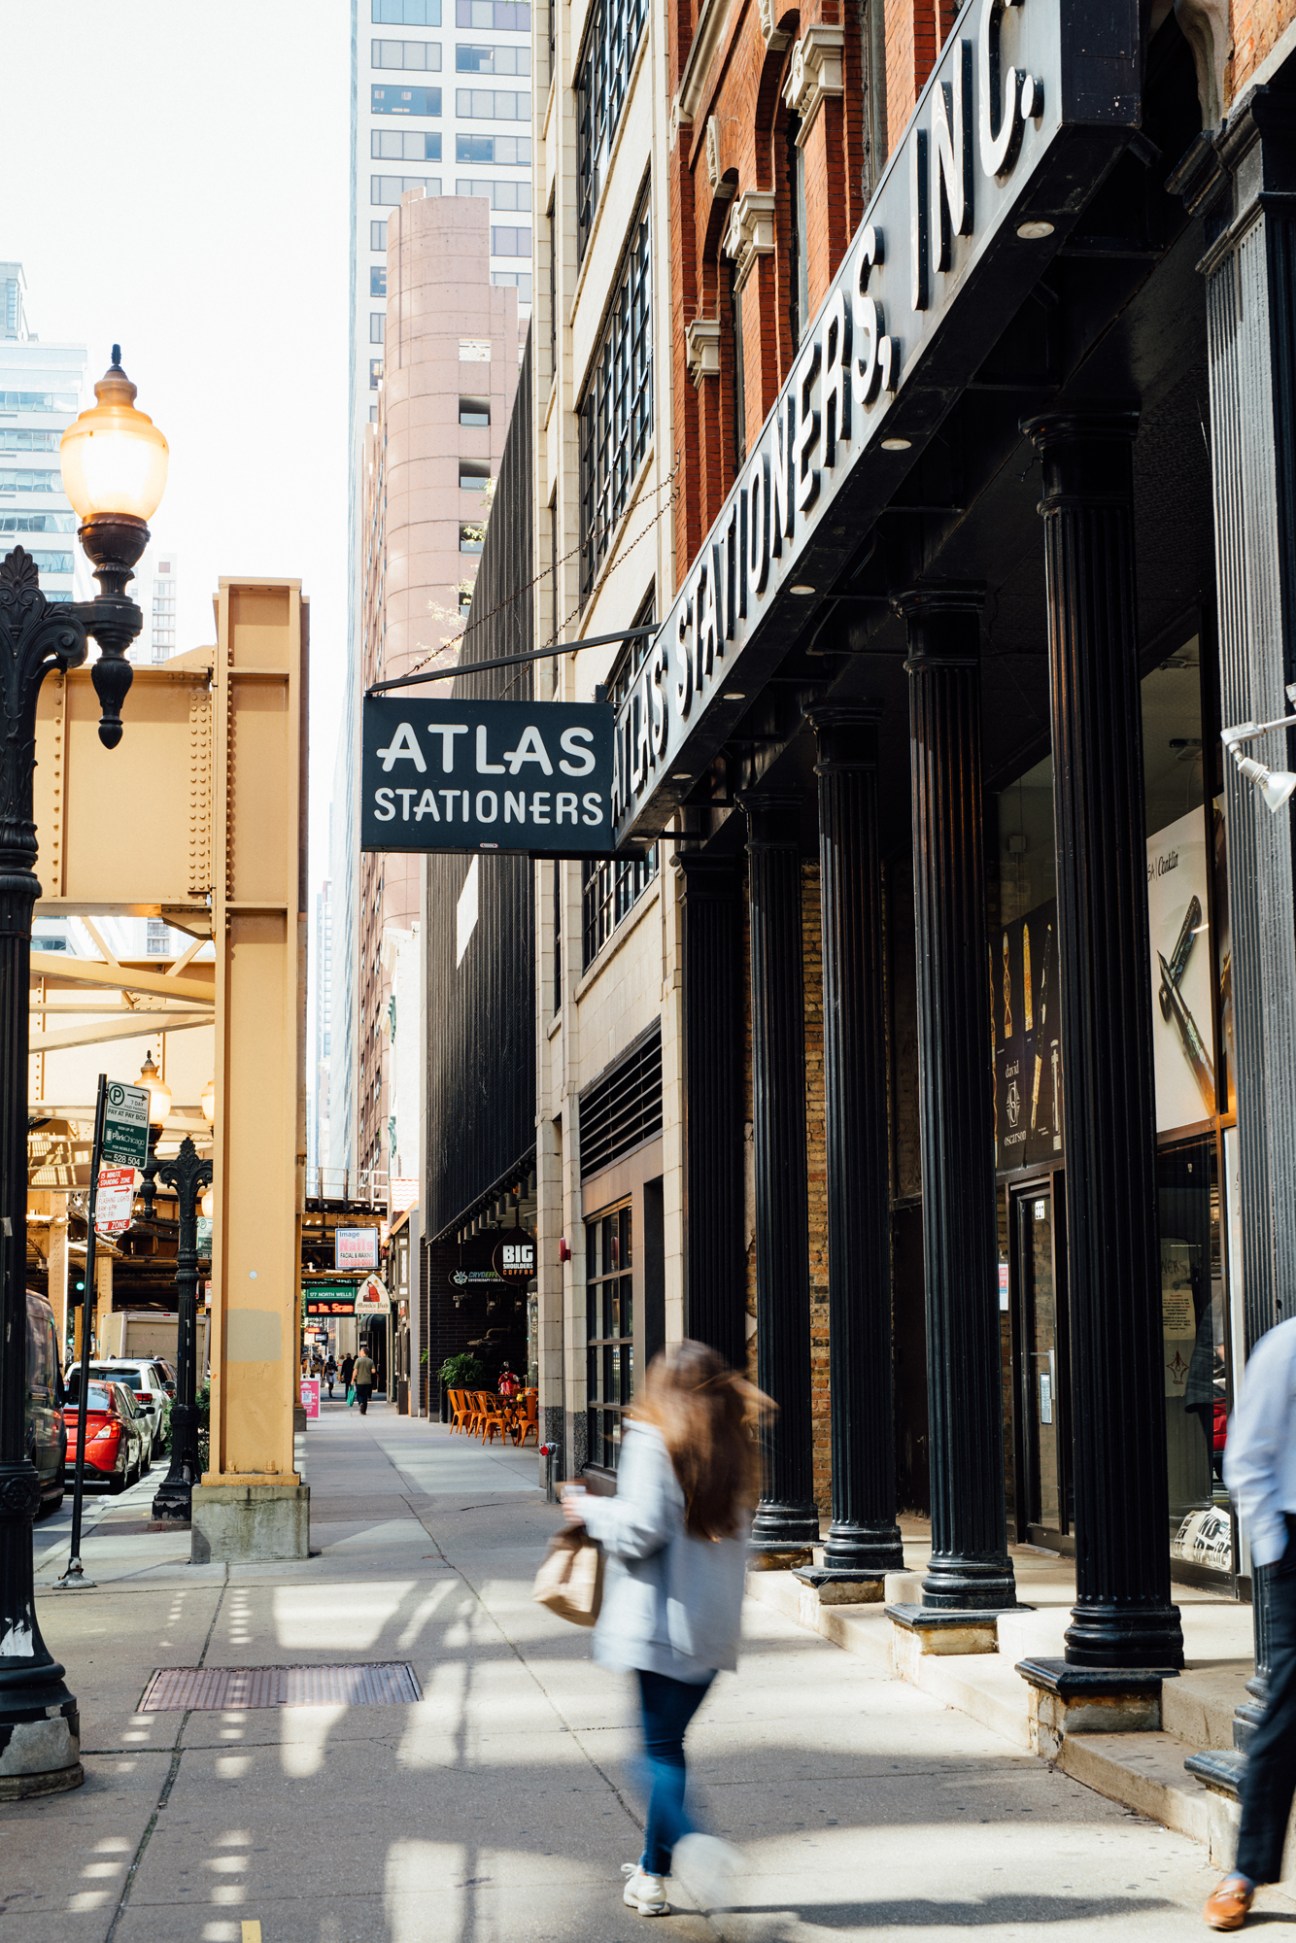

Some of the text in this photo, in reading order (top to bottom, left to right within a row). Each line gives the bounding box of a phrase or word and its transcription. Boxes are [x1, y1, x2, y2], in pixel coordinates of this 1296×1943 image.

[611, 0, 1044, 828] ATLAS STATIONERS, INC.
[376, 722, 596, 777] ATLAS
[373, 787, 604, 826] STATIONERS
[1005, 1060, 1020, 1079] david
[107, 1108, 117, 1116] PAY
[125, 1112, 135, 1120] PAY
[1003, 1129, 1027, 1147] oscarson
[113, 1153, 127, 1164] 528
[128, 1156, 140, 1166] 504
[111, 1220, 128, 1229] ZONE
[339, 1231, 360, 1239] Image
[502, 1245, 534, 1263] BIG
